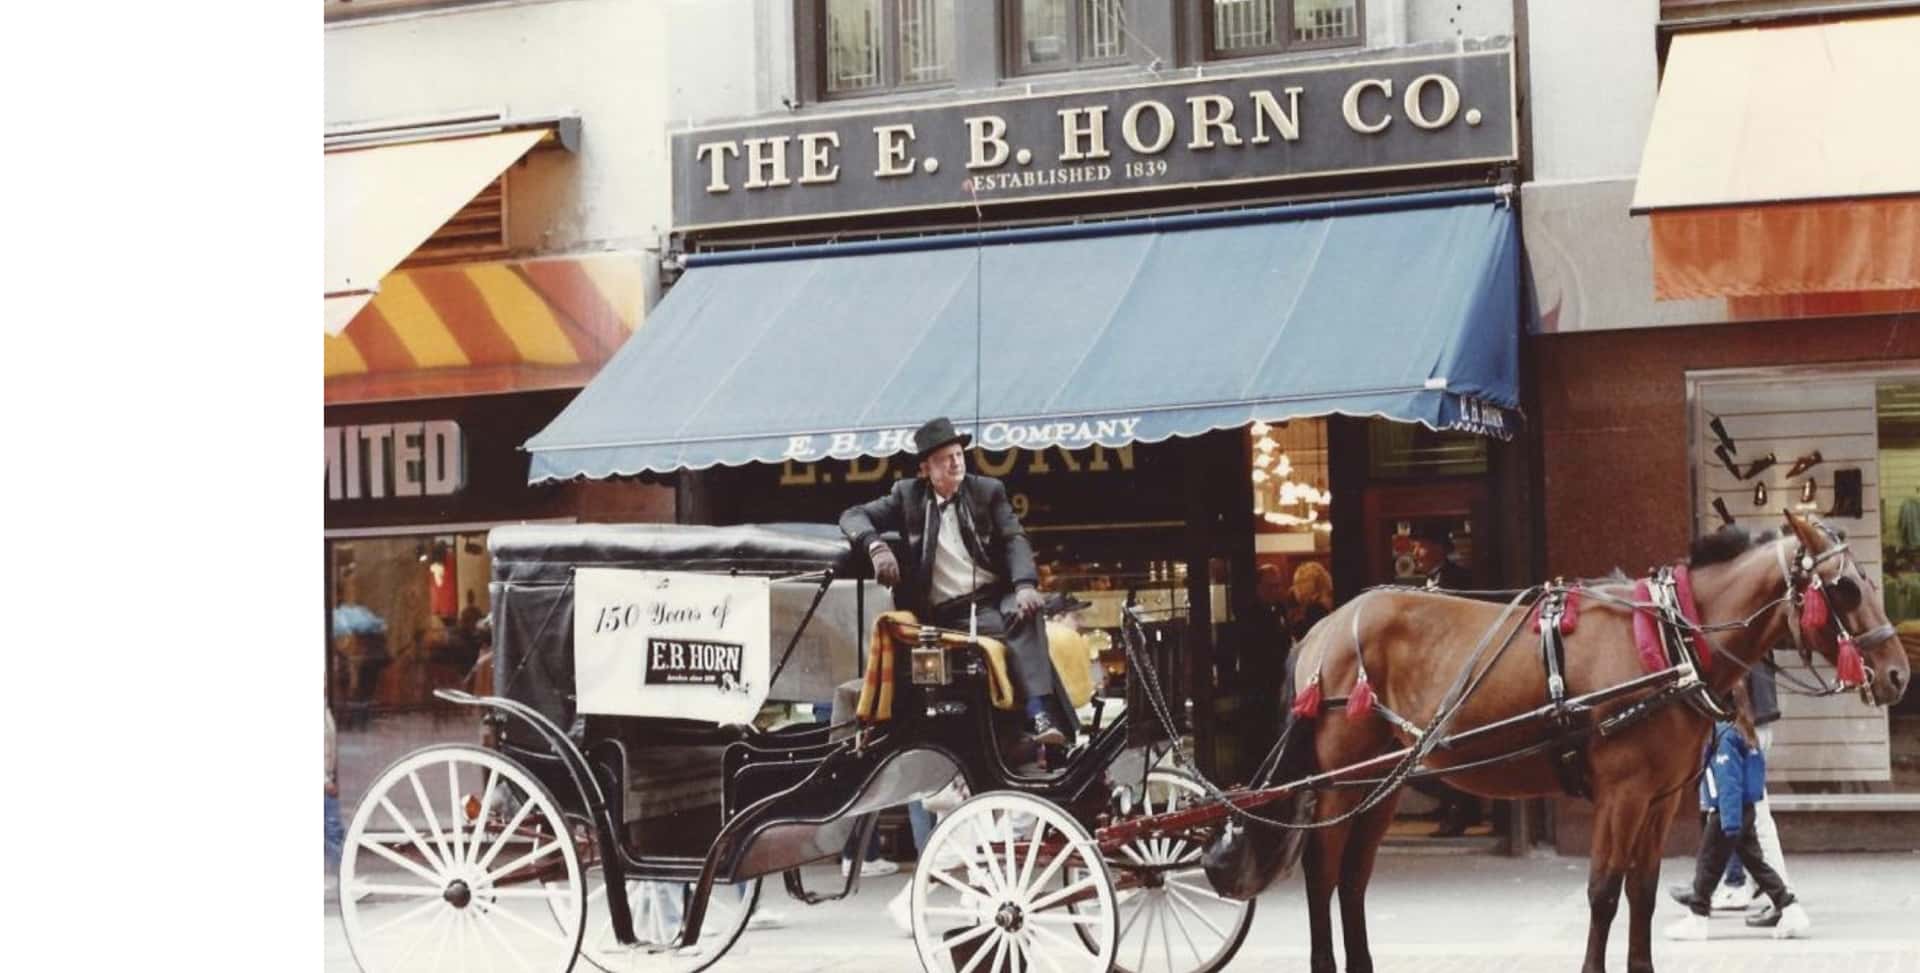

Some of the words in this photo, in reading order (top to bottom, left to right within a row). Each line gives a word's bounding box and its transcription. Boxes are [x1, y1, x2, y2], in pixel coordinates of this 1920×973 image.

[696, 131, 841, 192] THE
[873, 123, 939, 178] E.
[964, 115, 1032, 170] B.
[1057, 87, 1305, 161] HORN
[1342, 73, 1482, 134] CO.
[973, 165, 1111, 190] ESTABLISHED
[1124, 160, 1167, 178] 1839
[783, 435, 817, 456] E.
[982, 416, 1141, 444] COMPANY
[596, 605, 640, 633] 150
[650, 602, 702, 625] Years
[711, 595, 732, 629] of
[688, 644, 740, 671] HORN
